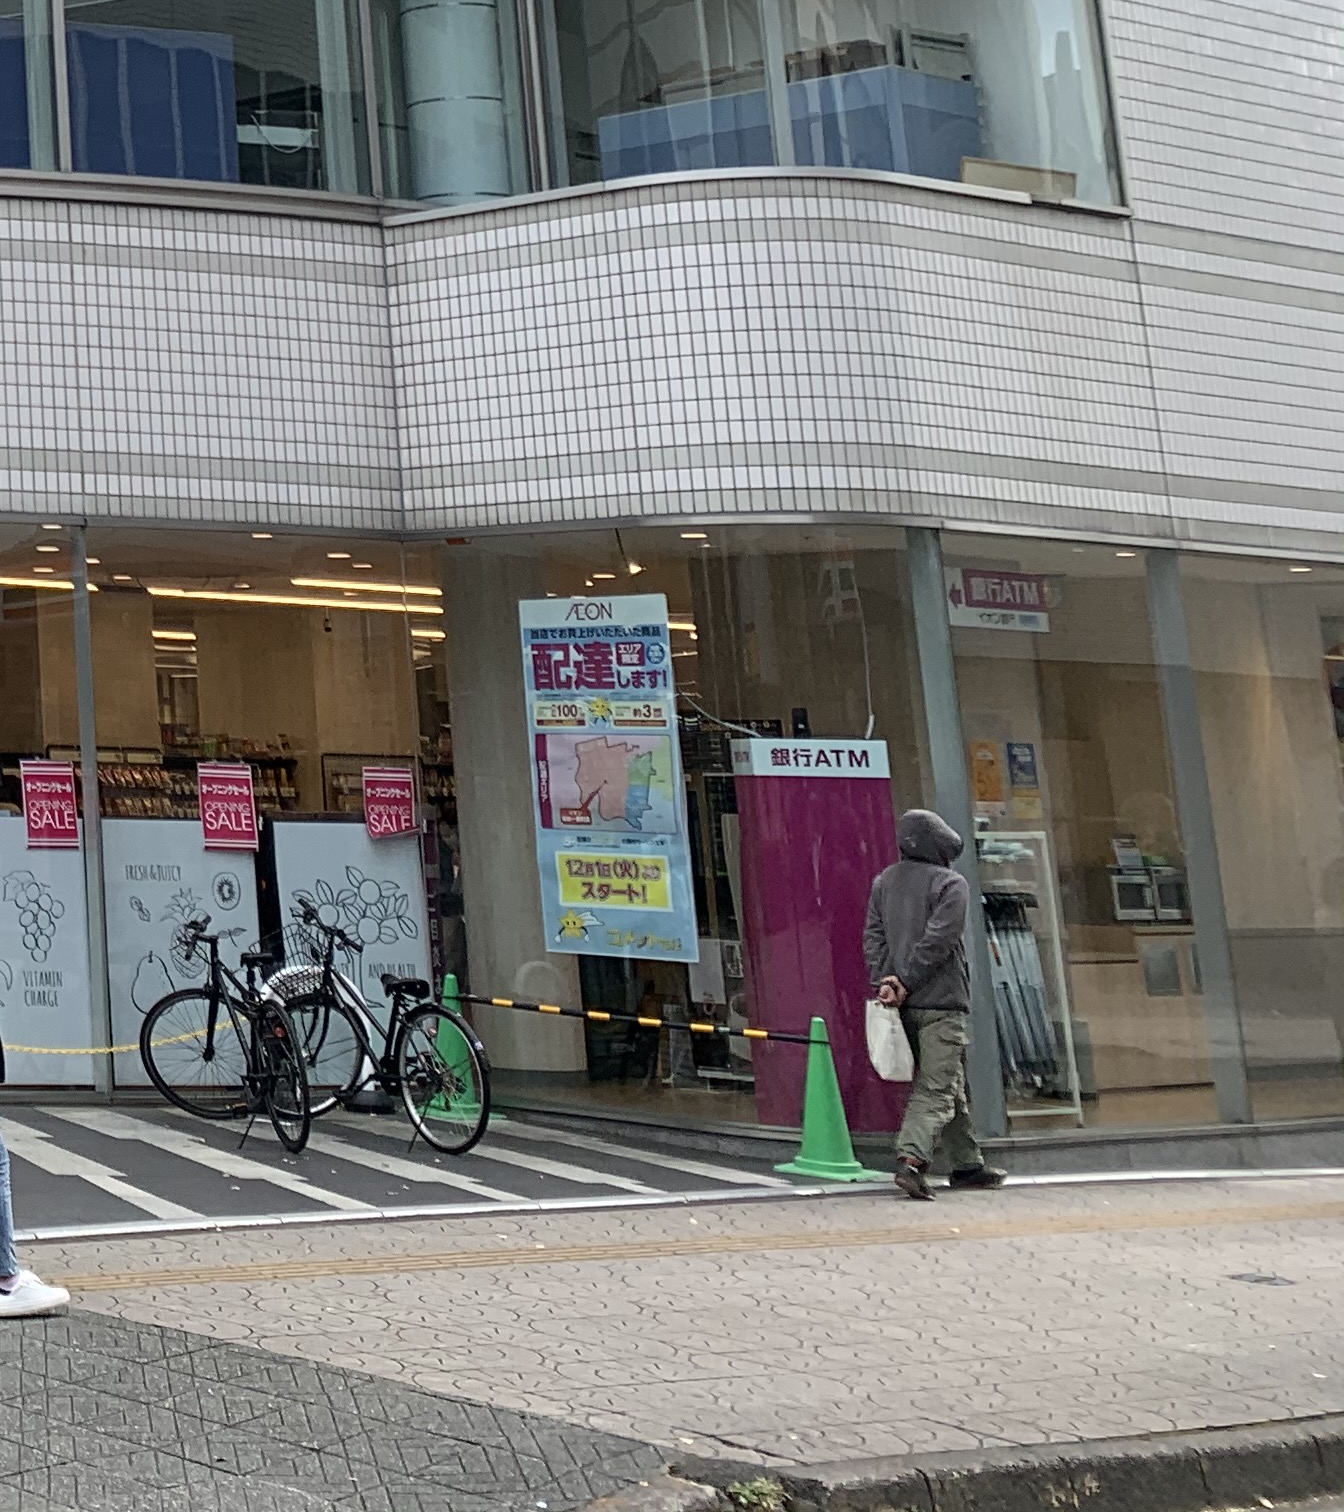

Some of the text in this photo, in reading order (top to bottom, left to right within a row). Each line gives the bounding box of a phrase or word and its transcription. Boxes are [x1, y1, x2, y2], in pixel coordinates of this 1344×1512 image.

[770, 748, 870, 769] 銀行ATM
[29, 799, 73, 810] OPENING
[204, 801, 251, 813] OPENING
[368, 804, 411, 816] OPENING
[30, 810, 75, 829] SALE
[205, 811, 253, 831] SALE
[22, 970, 63, 988] VITAMIN
[24, 989, 59, 1008] CHARGE
